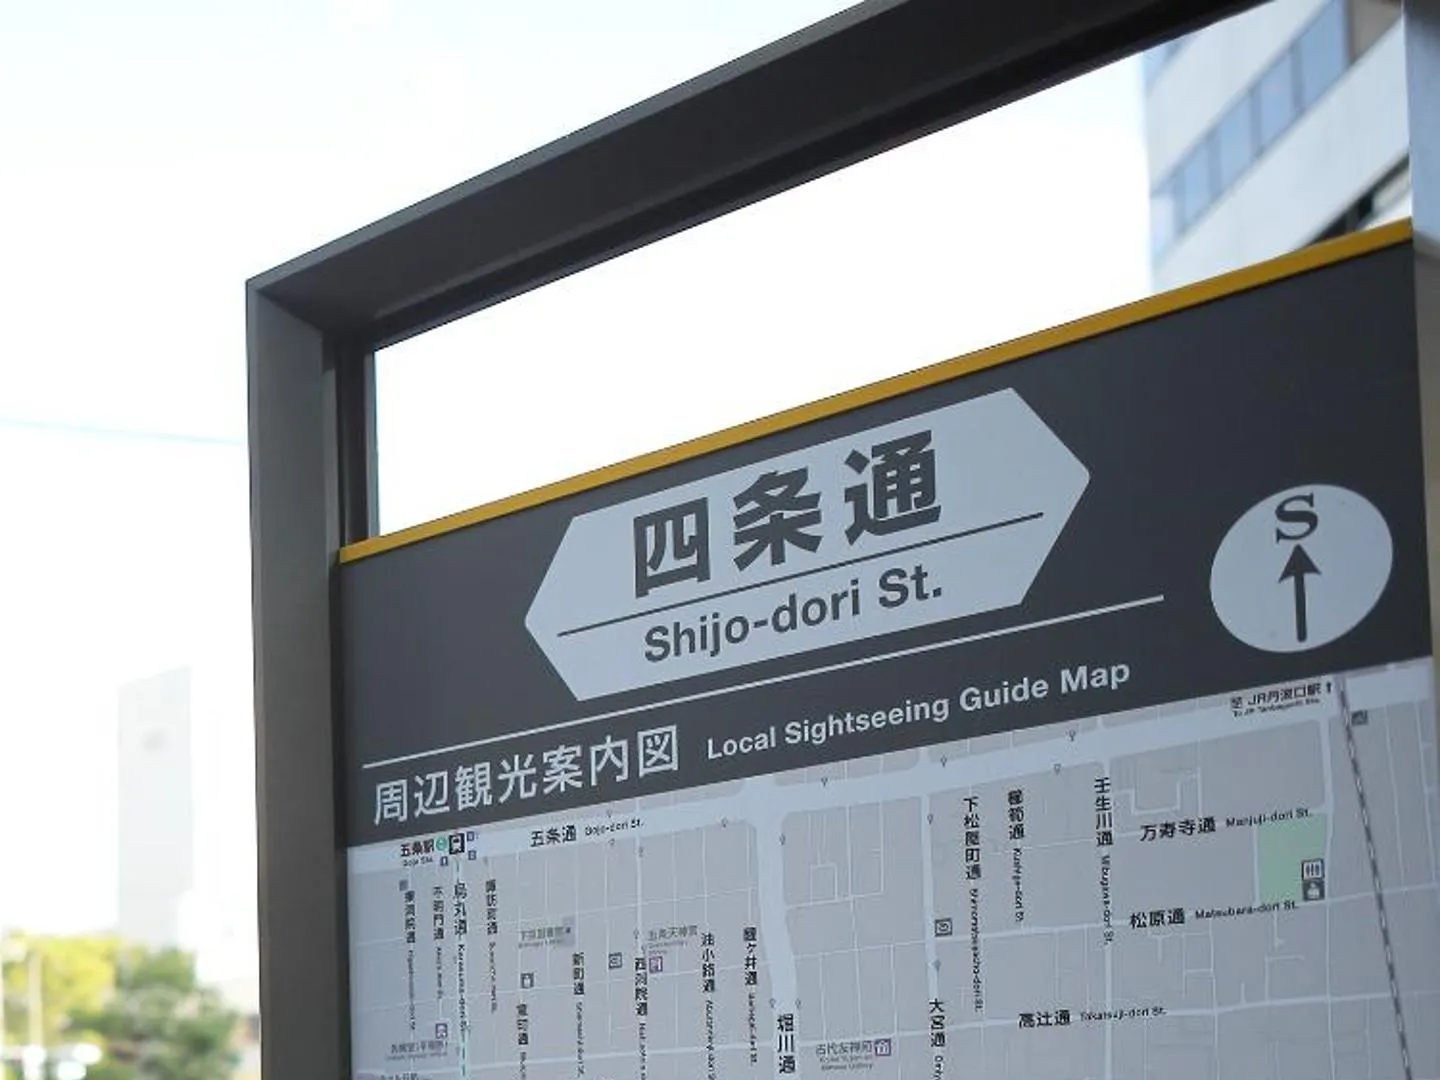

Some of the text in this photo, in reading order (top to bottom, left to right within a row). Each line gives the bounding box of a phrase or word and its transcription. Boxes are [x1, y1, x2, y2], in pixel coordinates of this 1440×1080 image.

[634, 430, 941, 599] 四条通
[1274, 493, 1319, 544] S
[644, 561, 944, 668] Shijo-dori St.
[706, 660, 1131, 763] Local Sightseeing Guide Map
[373, 722, 682, 828] 周辺観光案内図
[531, 824, 578, 848] 五条通
[963, 795, 982, 880] 下松屋町通
[1094, 777, 1114, 847] 壬生川通
[1140, 815, 1216, 843] 万寿寺通
[1129, 907, 1187, 930] 松原通
[929, 998, 946, 1049] 大宮通
[1018, 1009, 1072, 1029] 高辻通
